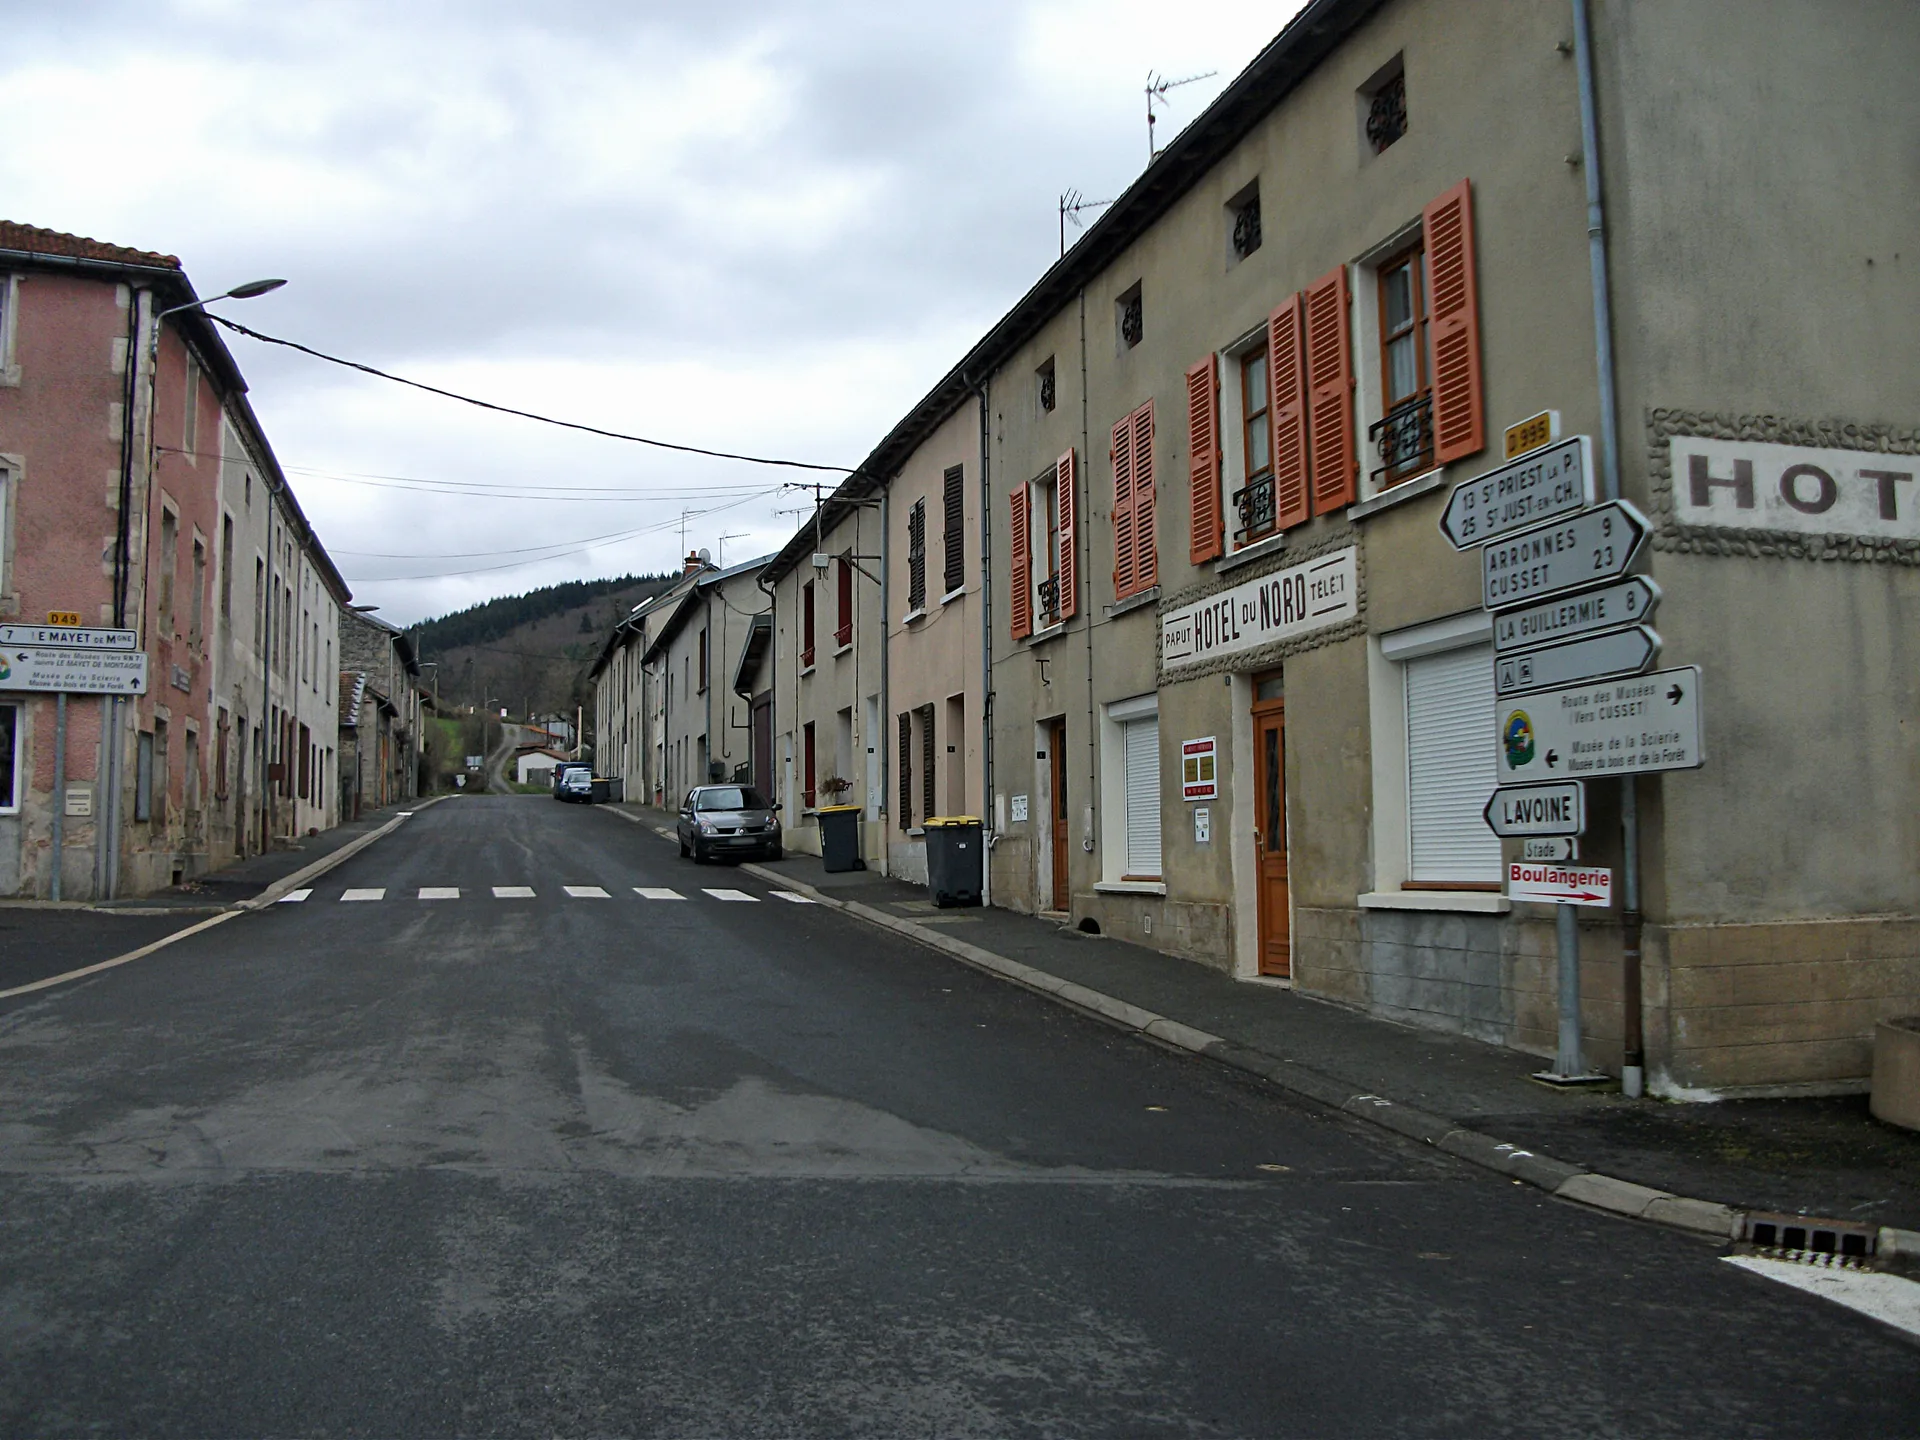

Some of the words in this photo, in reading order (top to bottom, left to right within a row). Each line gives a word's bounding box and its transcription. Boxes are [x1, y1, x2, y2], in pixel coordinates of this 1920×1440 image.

[1508, 434, 1517, 454] D
[1521, 420, 1547, 449] 995
[1463, 491, 1475, 511] 13
[1498, 464, 1544, 498] PRIEST
[1547, 467, 1559, 480] LA
[1687, 453, 1913, 521] HOT
[1461, 519, 1476, 538] 25
[1489, 528, 1577, 573] ARRONNES
[1602, 517, 1612, 538] 9
[1489, 563, 1549, 598] CUSSET
[1592, 546, 1614, 570] 23
[51, 614, 59, 624] D
[61, 614, 77, 625] 49
[1165, 627, 1191, 649] PAPUT
[1194, 597, 1240, 652] HOTEL
[1242, 600, 1256, 625] DU
[1259, 573, 1306, 631] NORD
[1500, 621, 1515, 642] LA
[1520, 597, 1606, 636] GUILLERMIE
[1626, 590, 1636, 612] 8
[7, 630, 13, 640] 7
[49, 631, 91, 644] MAYET
[35, 651, 56, 659] Route
[58, 651, 71, 659] des
[66, 660, 91, 668] MAYET
[92, 661, 101, 669] DE
[32, 671, 61, 680] Musée
[65, 672, 75, 680] de
[79, 673, 87, 681] la
[91, 673, 121, 682] Scierie
[53, 680, 62, 688] du
[63, 680, 77, 689] bois
[1561, 694, 1589, 709] Route
[1594, 689, 1611, 704] des
[1616, 683, 1656, 700] Musées
[1572, 738, 1604, 755] Musée
[1609, 735, 1621, 750] de
[1626, 734, 1635, 748] la
[1640, 729, 1681, 747] Scierie
[1568, 755, 1593, 772] Musée
[1596, 755, 1605, 769] du
[1607, 753, 1625, 768] bois
[1627, 753, 1636, 766] et
[1639, 751, 1649, 765] de
[1652, 750, 1660, 763] la
[1662, 747, 1685, 763] Forêt
[1503, 795, 1571, 825] LAVOINE
[1526, 839, 1556, 858] Stade
[1510, 864, 1610, 889] Boulangerie
